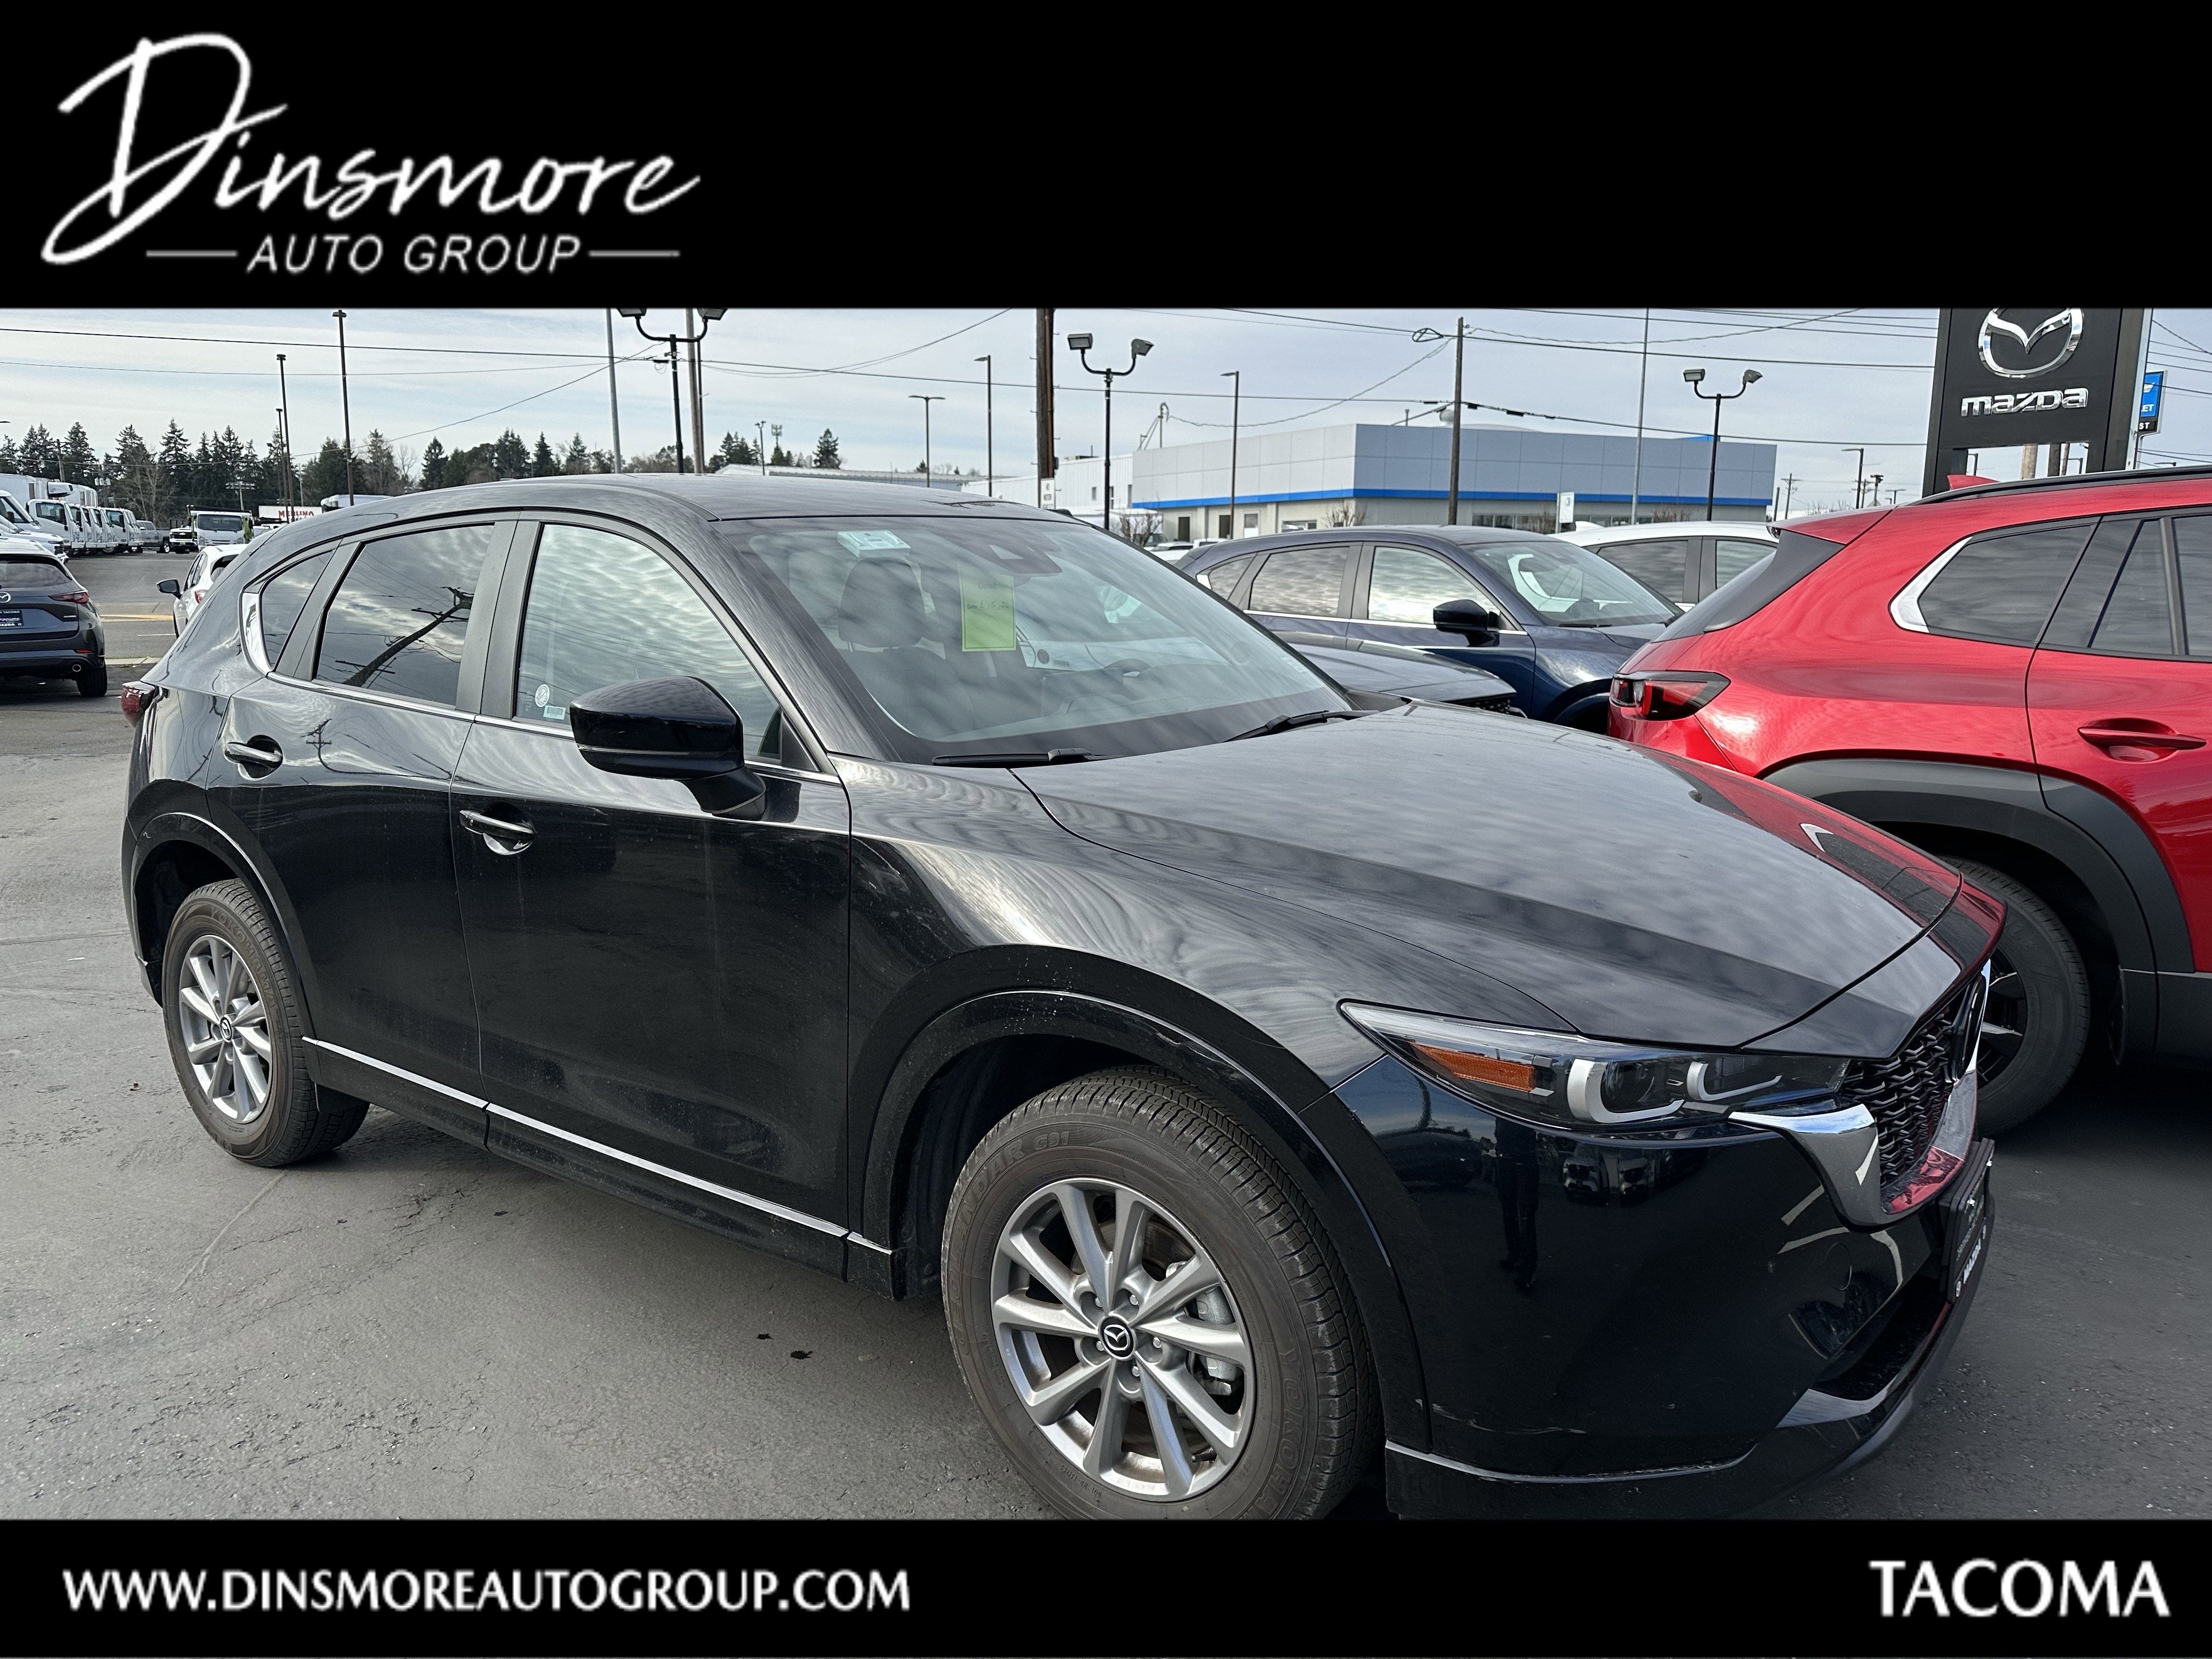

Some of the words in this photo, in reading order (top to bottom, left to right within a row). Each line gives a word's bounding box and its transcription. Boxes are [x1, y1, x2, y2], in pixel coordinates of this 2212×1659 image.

[212, 906, 275, 1008] YOKOHAMA
[950, 1139, 1025, 1355] GEOLANDAR
[1035, 1132, 1070, 1152] G91
